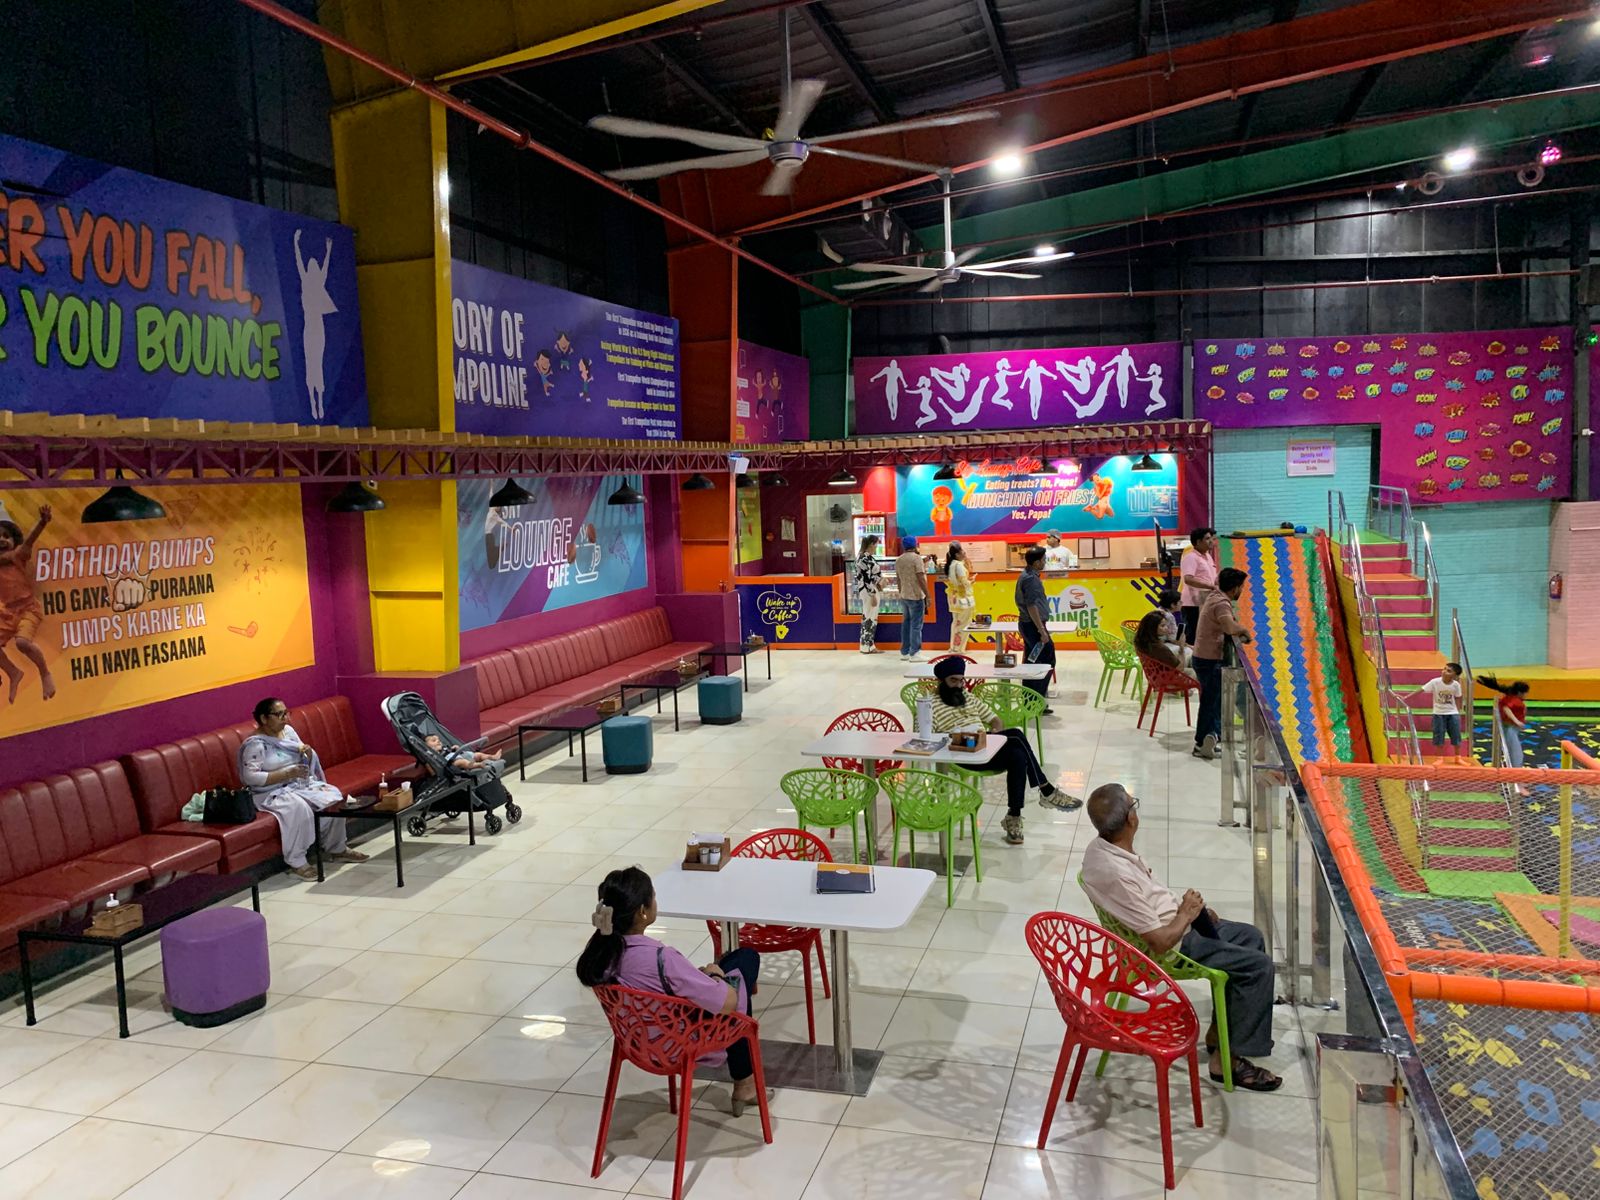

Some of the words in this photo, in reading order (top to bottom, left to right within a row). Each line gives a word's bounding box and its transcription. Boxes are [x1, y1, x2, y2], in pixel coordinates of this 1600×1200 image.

[58, 205, 153, 291] YOU
[166, 231, 261, 315] FALL,
[20, 289, 121, 369] YOU
[136, 305, 281, 380] BOUNCE
[501, 310, 524, 360] OF
[967, 491, 1032, 508] MUNCHING
[1034, 491, 1052, 507] ON
[985, 479, 1010, 490] Eating
[1012, 511, 1027, 521] Yes,
[1028, 509, 1052, 521] Papa!
[35, 543, 145, 582] BIRTHDAY
[149, 537, 215, 571] BUMPS
[498, 518, 572, 572] LOUNGE
[43, 591, 66, 615] HO
[71, 585, 110, 611] GAYA
[151, 573, 215, 603] PURAANA
[547, 564, 570, 589] CAFE
[62, 614, 123, 649] JUMPS
[128, 605, 182, 638] KARNE
[186, 603, 207, 627] KA
[769, 610, 792, 621] Coffee
[71, 655, 99, 681] HAI
[102, 647, 141, 674] NAYA
[144, 636, 207, 667] FASAANA
